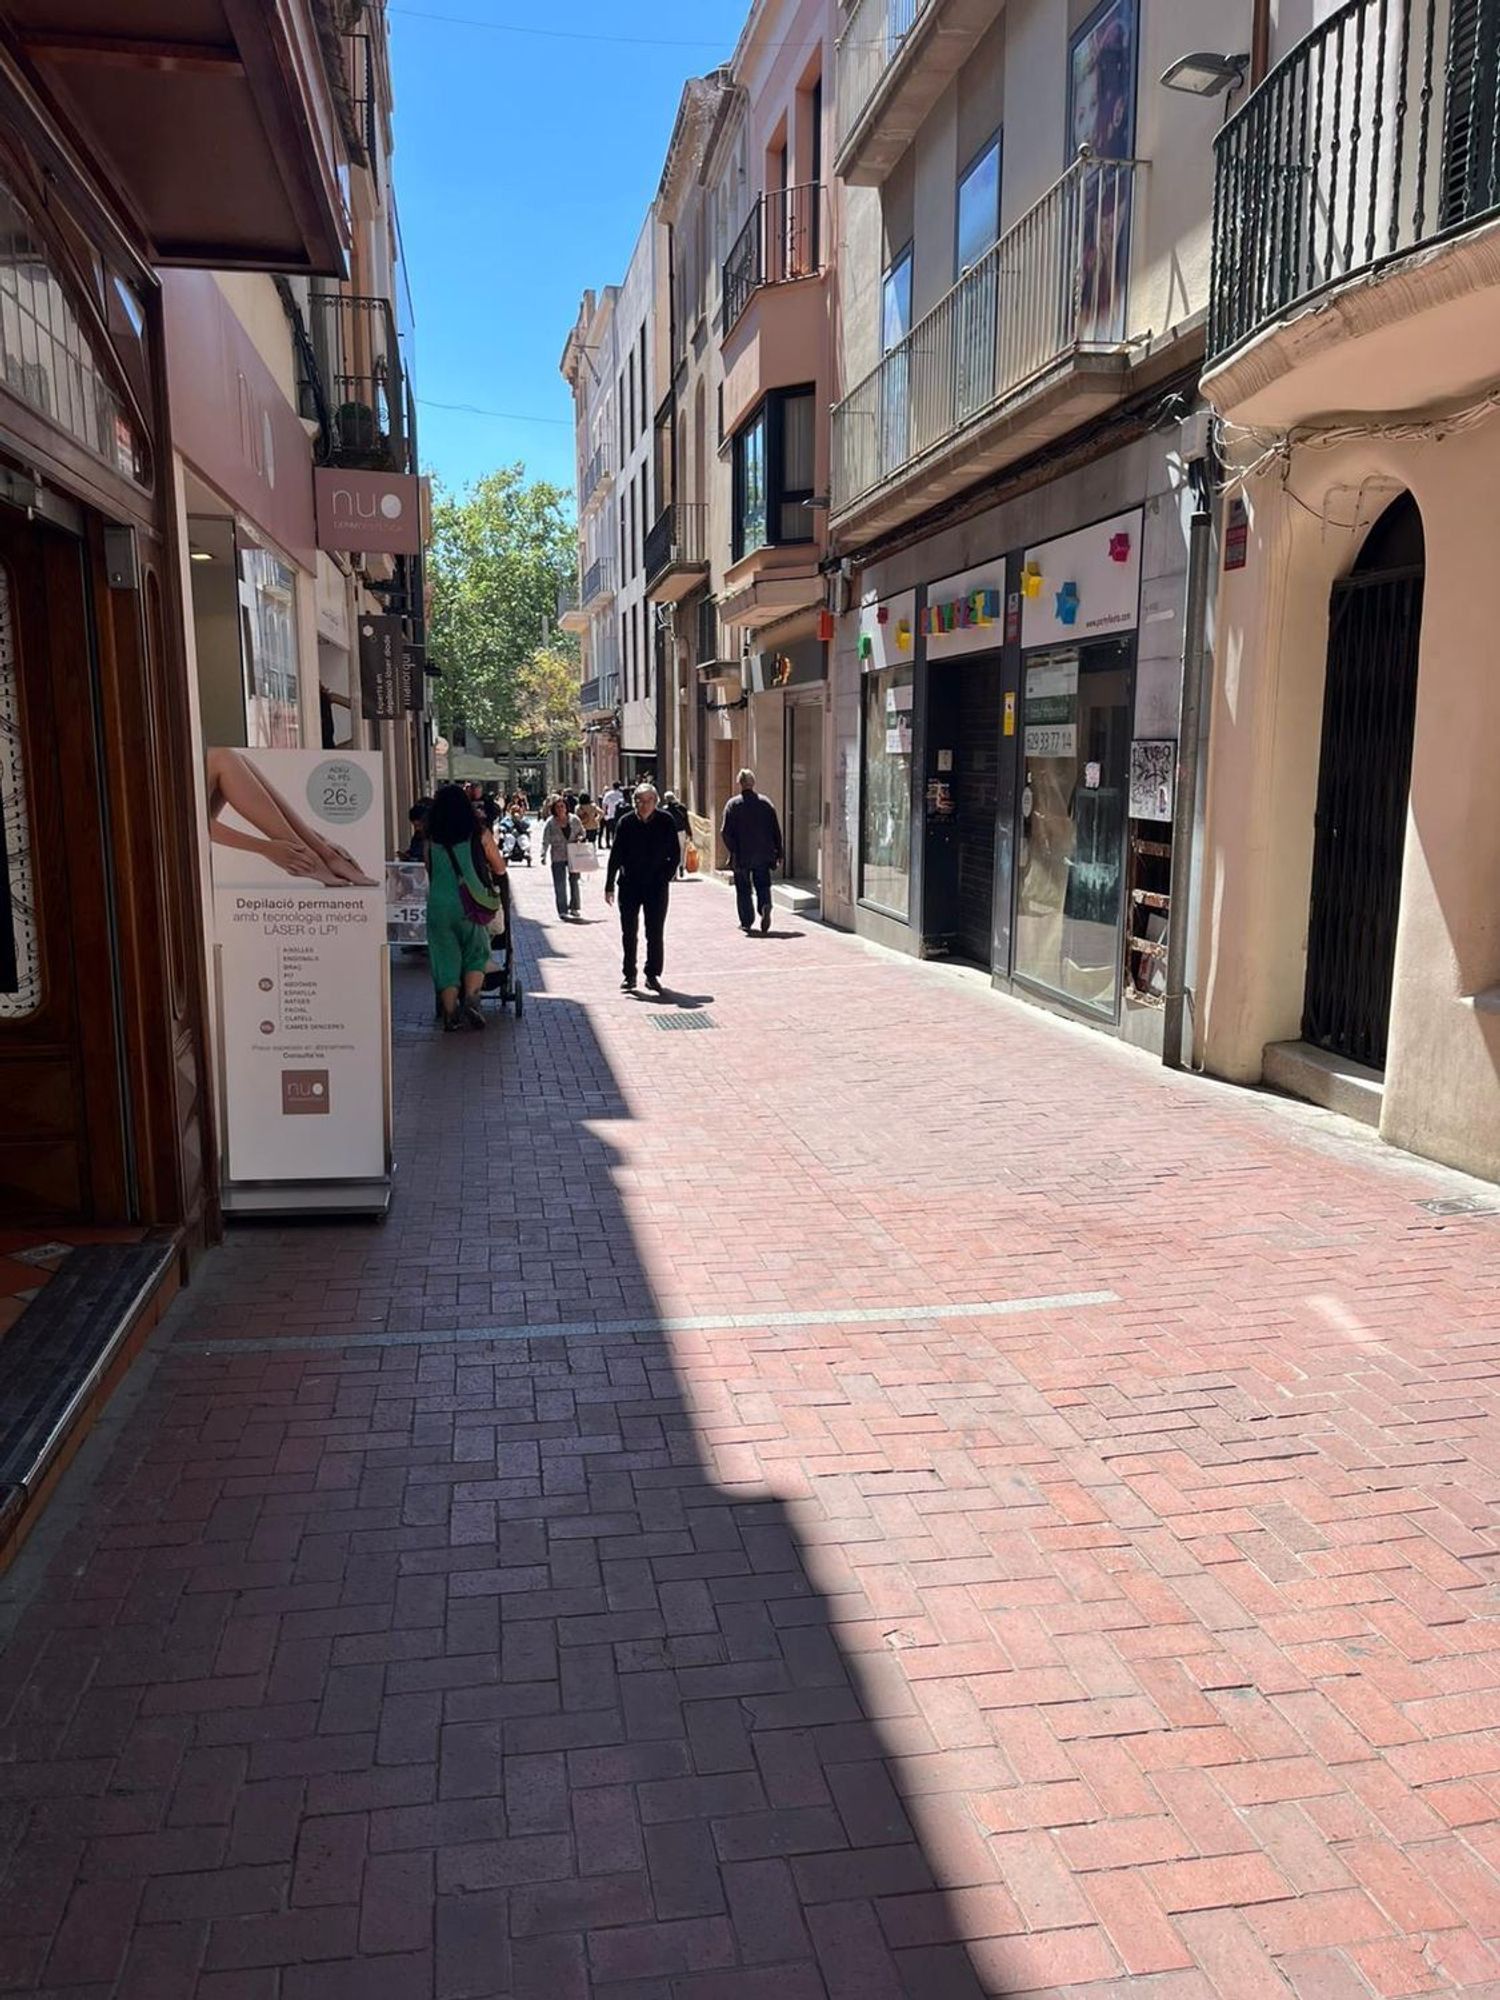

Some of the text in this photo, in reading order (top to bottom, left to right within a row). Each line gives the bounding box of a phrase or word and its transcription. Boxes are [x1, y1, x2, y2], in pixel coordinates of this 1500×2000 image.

[236, 898, 364, 911] Depilació permanent
[233, 912, 259, 922] amb
[262, 911, 322, 924] tecnologia
[308, 927, 316, 936] o
